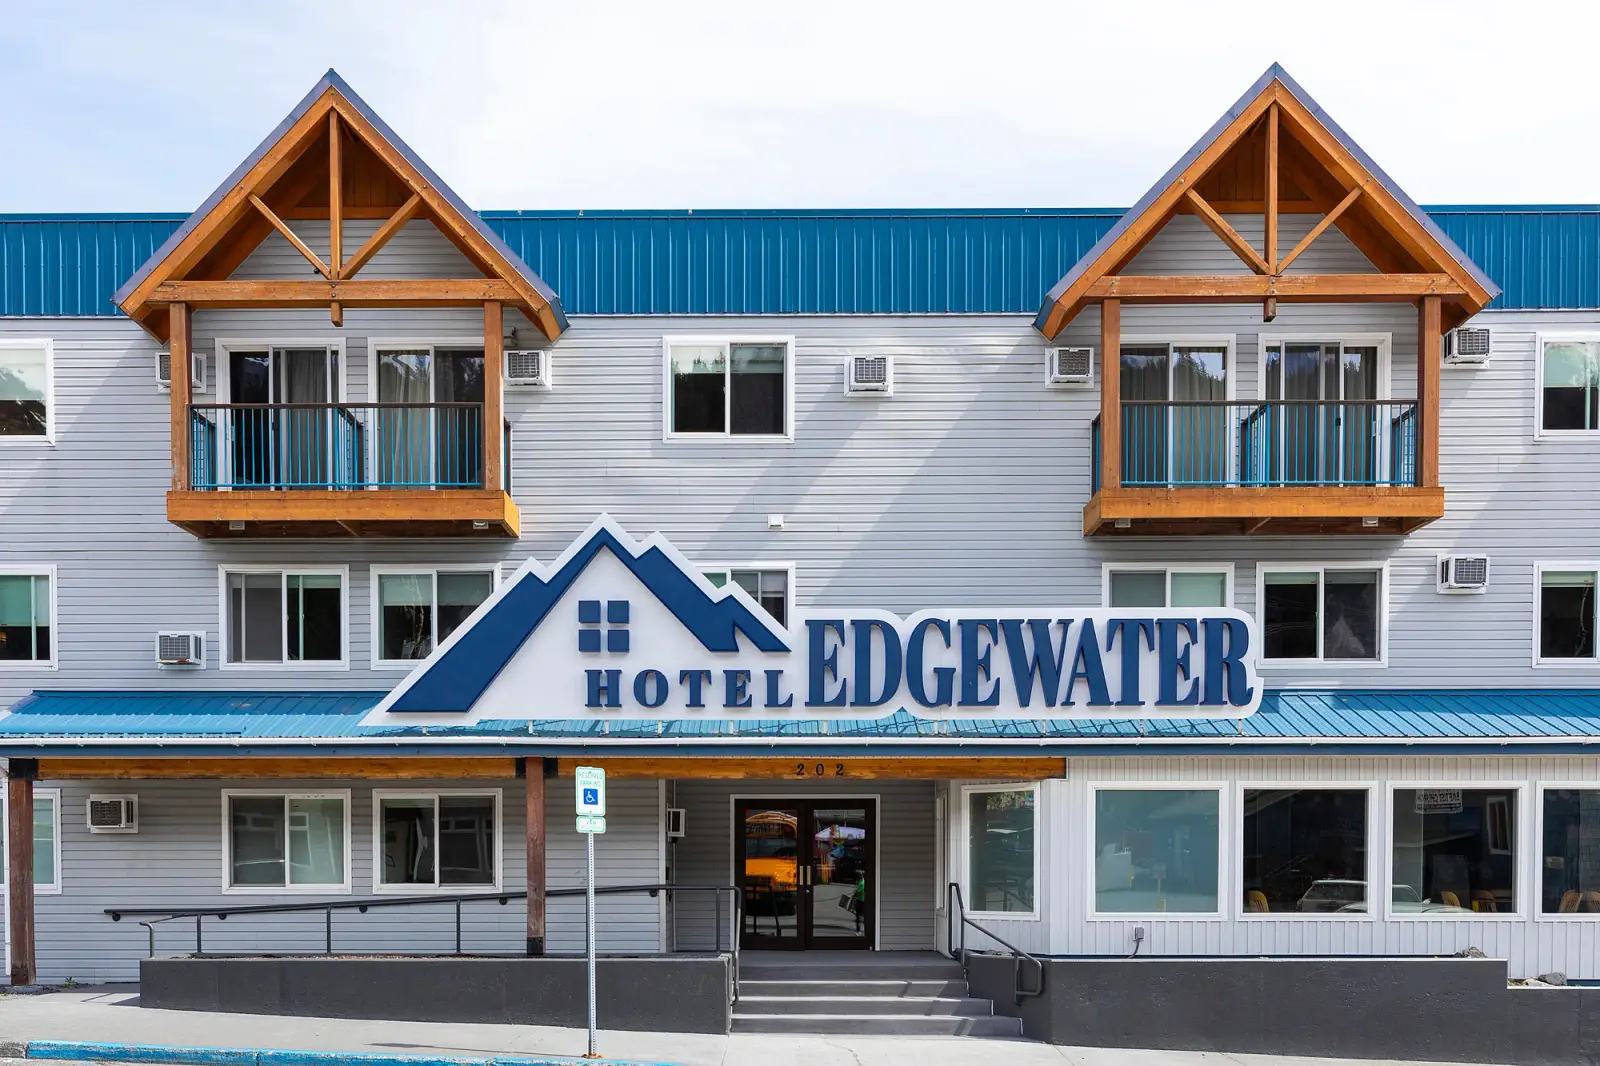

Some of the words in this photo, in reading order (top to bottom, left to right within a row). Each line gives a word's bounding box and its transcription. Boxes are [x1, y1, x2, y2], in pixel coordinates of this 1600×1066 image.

[585, 669, 793, 709] HOTEL
[804, 618, 1253, 708] EDGEWATER
[796, 763, 844, 776] 202
[578, 771, 602, 780] RESERVED
[580, 779, 601, 787] PARKING
